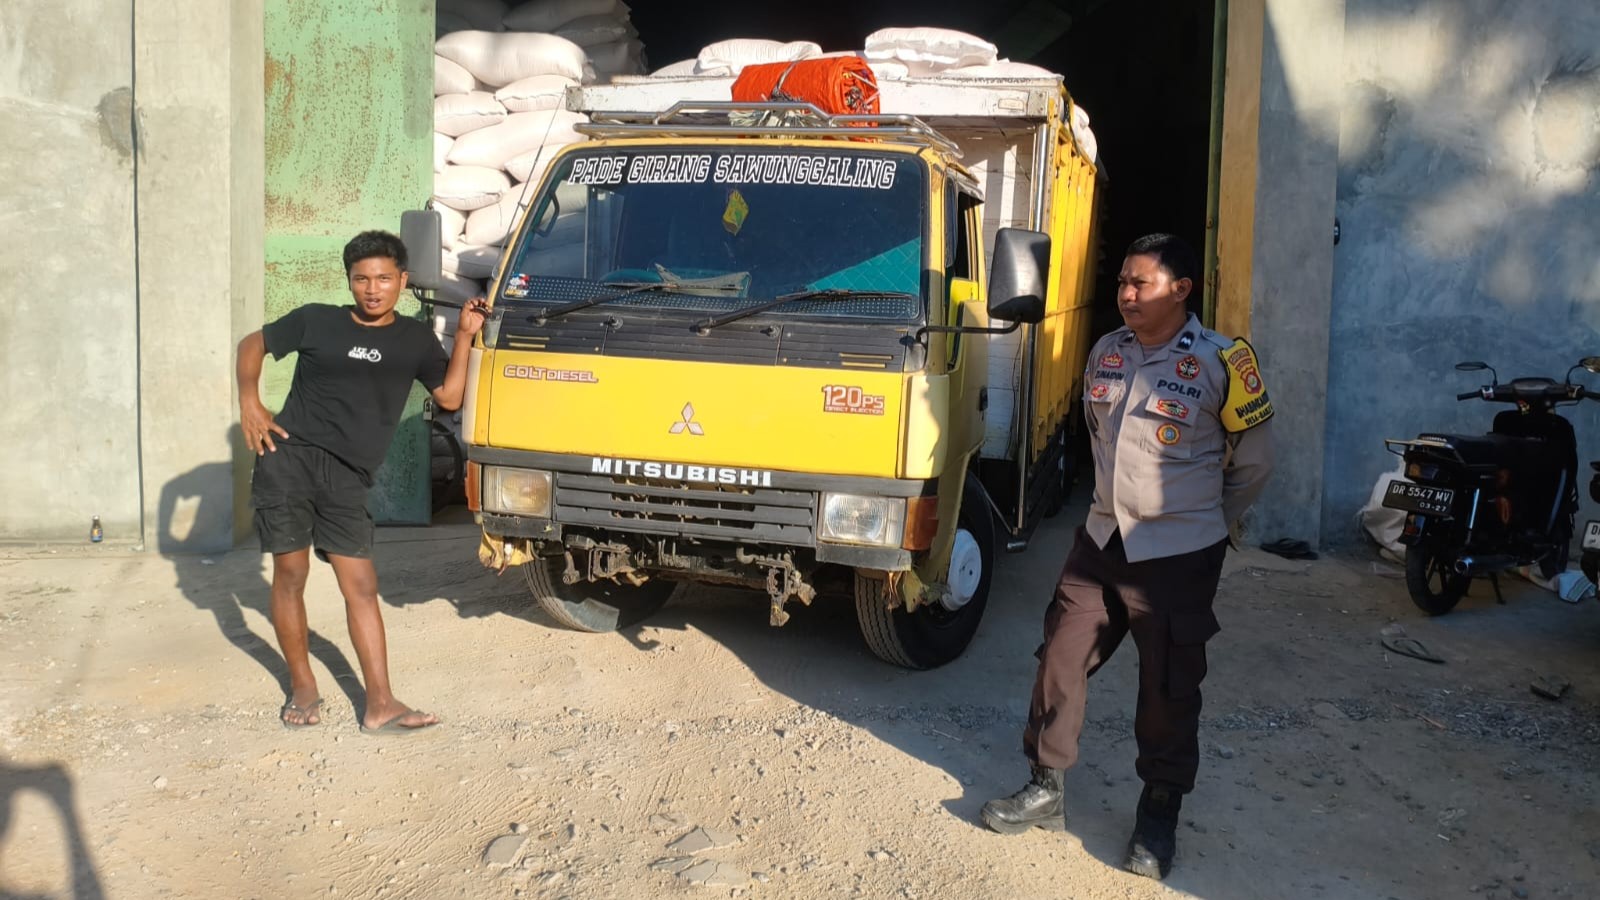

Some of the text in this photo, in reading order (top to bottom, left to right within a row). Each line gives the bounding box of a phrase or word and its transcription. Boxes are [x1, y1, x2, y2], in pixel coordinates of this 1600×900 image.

[568, 155, 897, 189] PADE GIRANG SAWUNGGALING
[1157, 379, 1202, 399] POLRI
[592, 457, 772, 487] MITSUBISHI
[1392, 484, 1450, 502] DR 5547 MV
